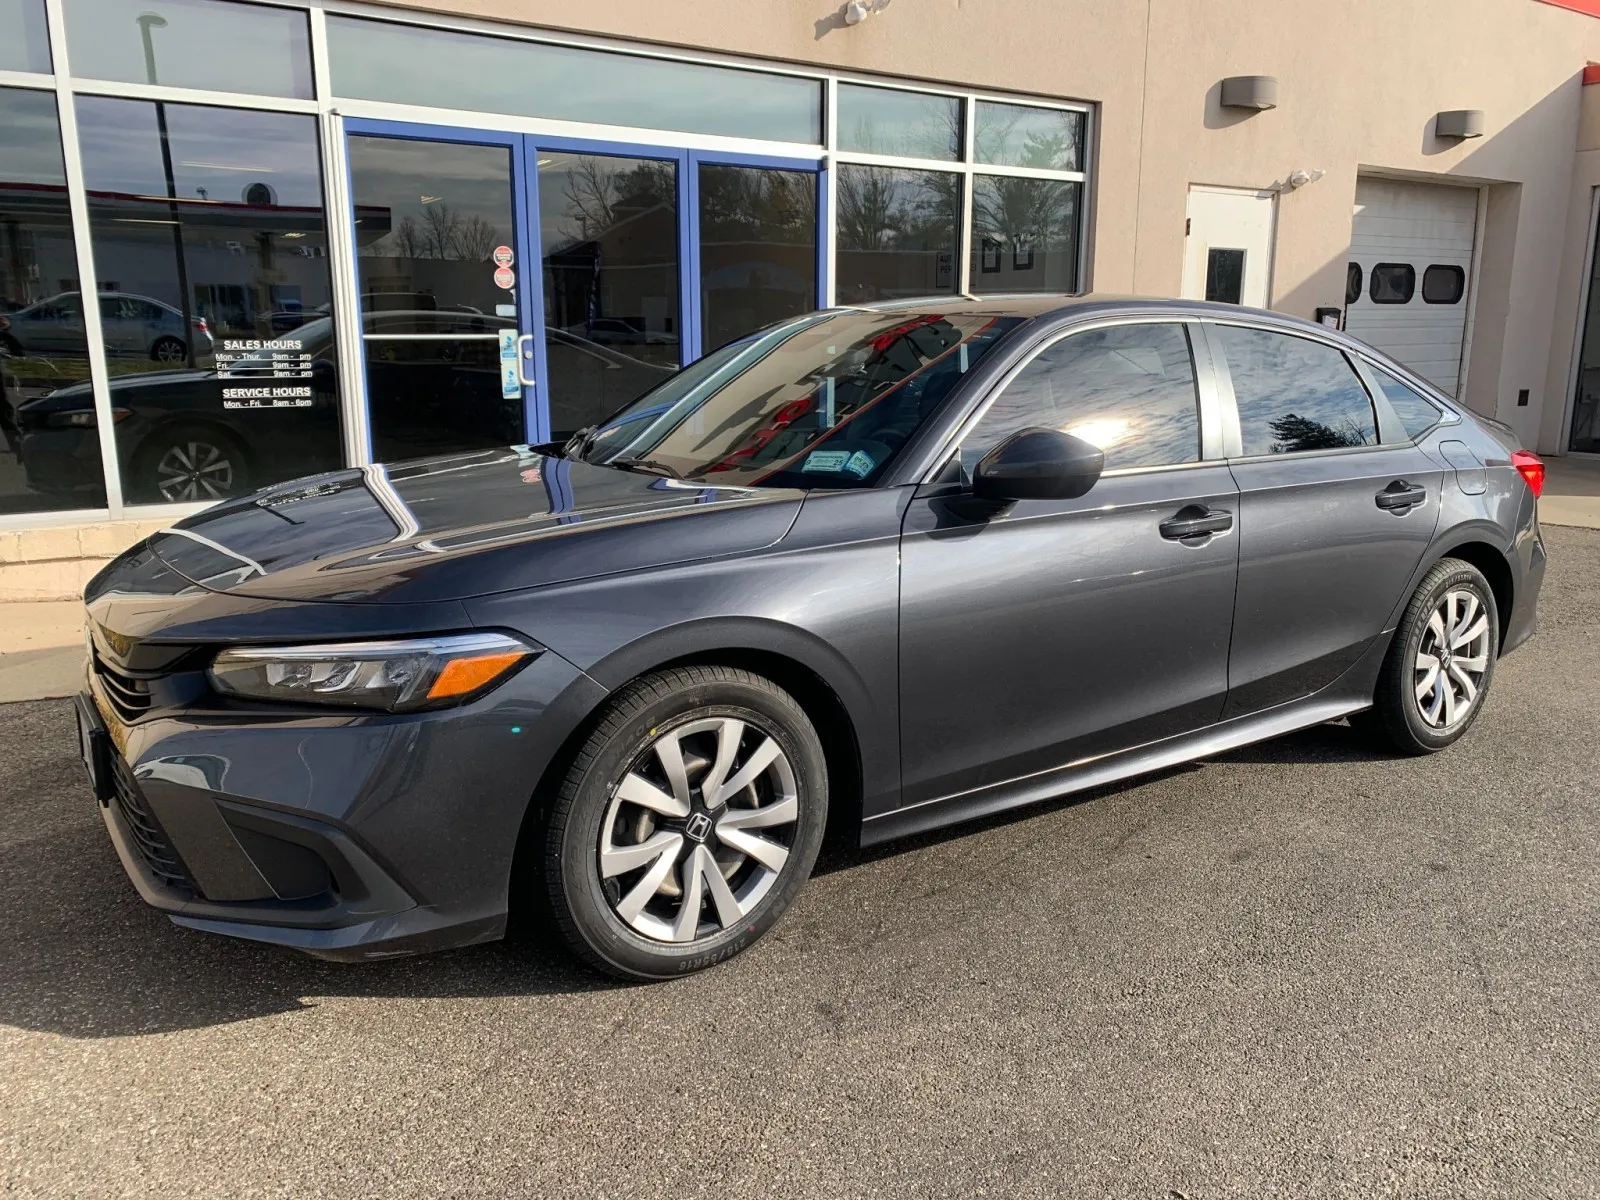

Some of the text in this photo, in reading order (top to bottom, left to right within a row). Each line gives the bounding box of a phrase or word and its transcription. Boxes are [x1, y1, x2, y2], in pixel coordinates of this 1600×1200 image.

[223, 340, 302, 349] SALES HOURS
[272, 361, 289, 369] 9am
[222, 387, 311, 397] SERVICE HOURS
[249, 400, 262, 408] Fri.
[272, 399, 289, 407] 8am
[296, 399, 312, 407] 6pm
[679, 938, 745, 971] 215/55R16
